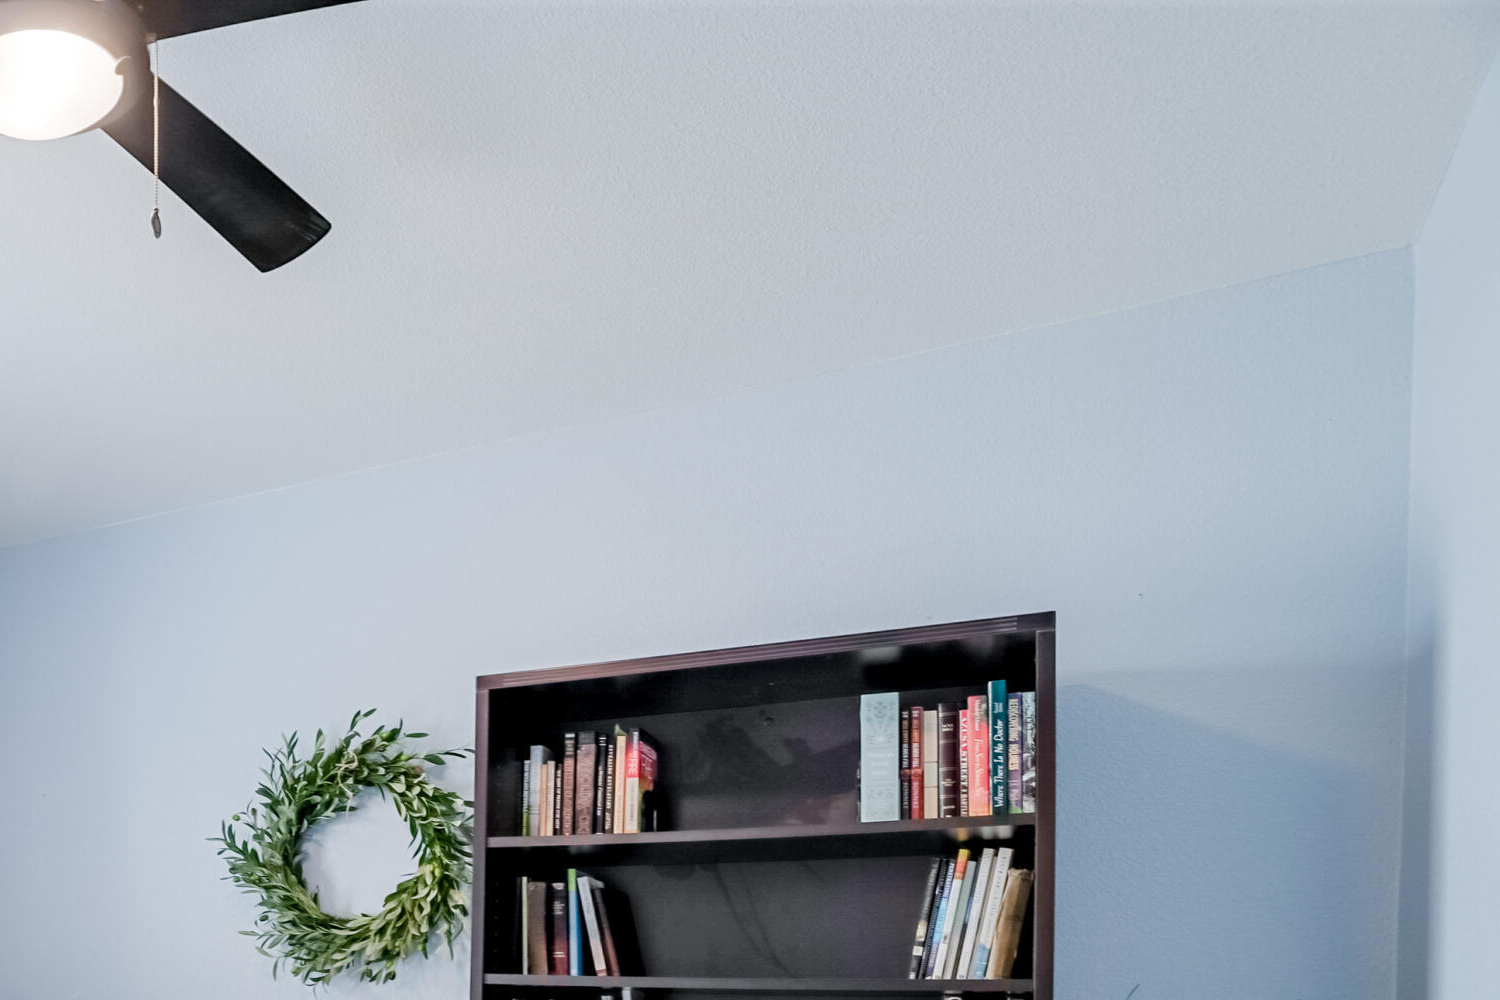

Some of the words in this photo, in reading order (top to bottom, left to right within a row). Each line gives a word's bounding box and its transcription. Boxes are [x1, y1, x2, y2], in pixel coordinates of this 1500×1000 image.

[960, 717, 969, 748] AZUSA
[994, 719, 1004, 740] Doctor
[993, 741, 1004, 753] No
[960, 751, 969, 786] STREET
[993, 765, 1005, 785] There
[993, 786, 1005, 808] Where
